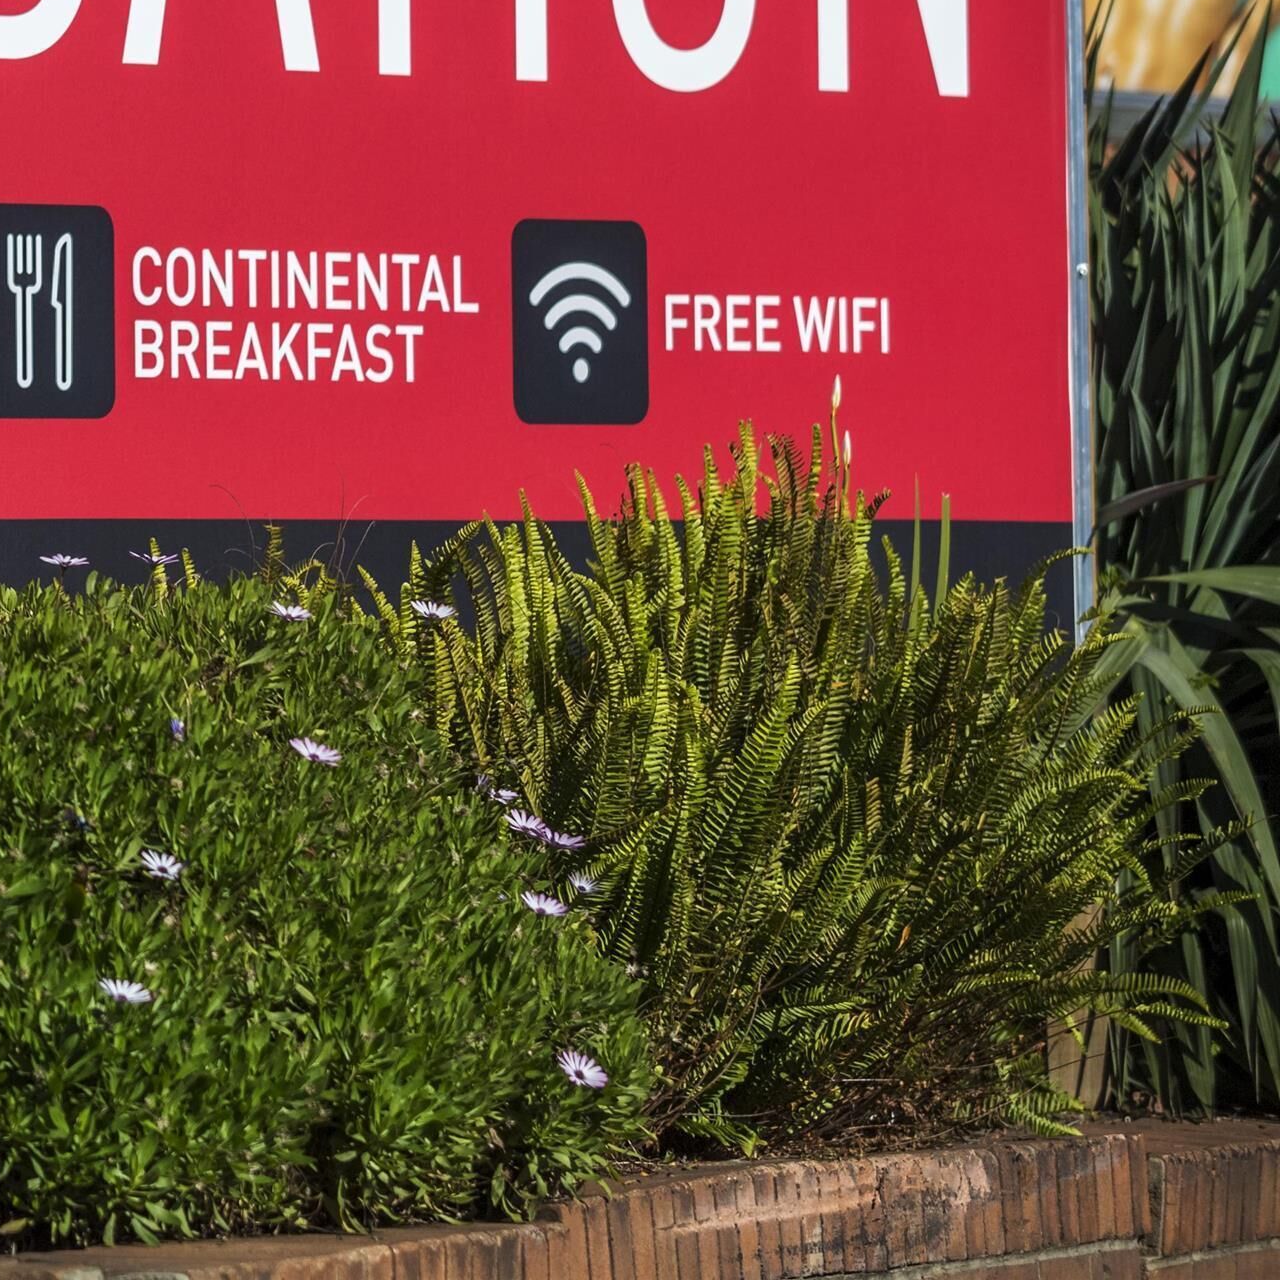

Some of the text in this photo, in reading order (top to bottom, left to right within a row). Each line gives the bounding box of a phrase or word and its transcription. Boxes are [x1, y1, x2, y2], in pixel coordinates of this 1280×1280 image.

[132, 246, 481, 314] CONTINENTAL
[134, 319, 425, 384] BREAKFAST
[665, 294, 891, 355] FREE WIFI
